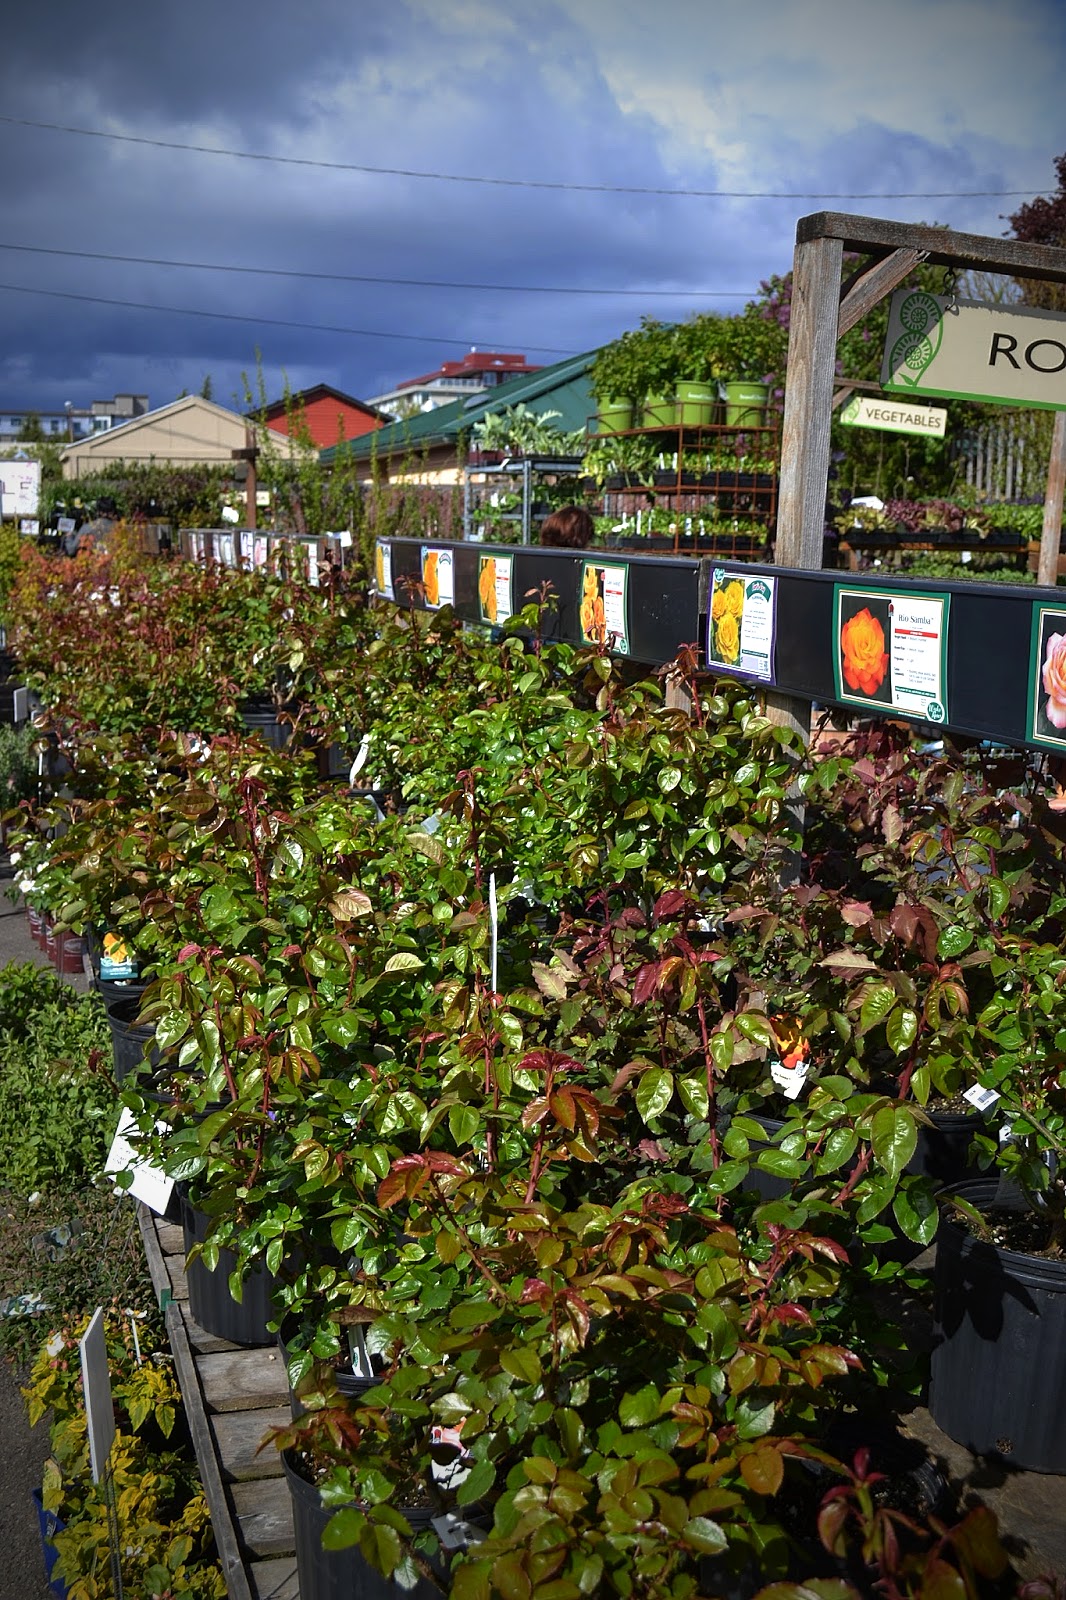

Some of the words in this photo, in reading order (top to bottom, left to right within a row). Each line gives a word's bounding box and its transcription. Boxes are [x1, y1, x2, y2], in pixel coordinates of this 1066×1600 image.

[988, 332, 1066, 373] RO
[865, 407, 942, 428] VEGETABLES
[898, 614, 909, 622] Rio
